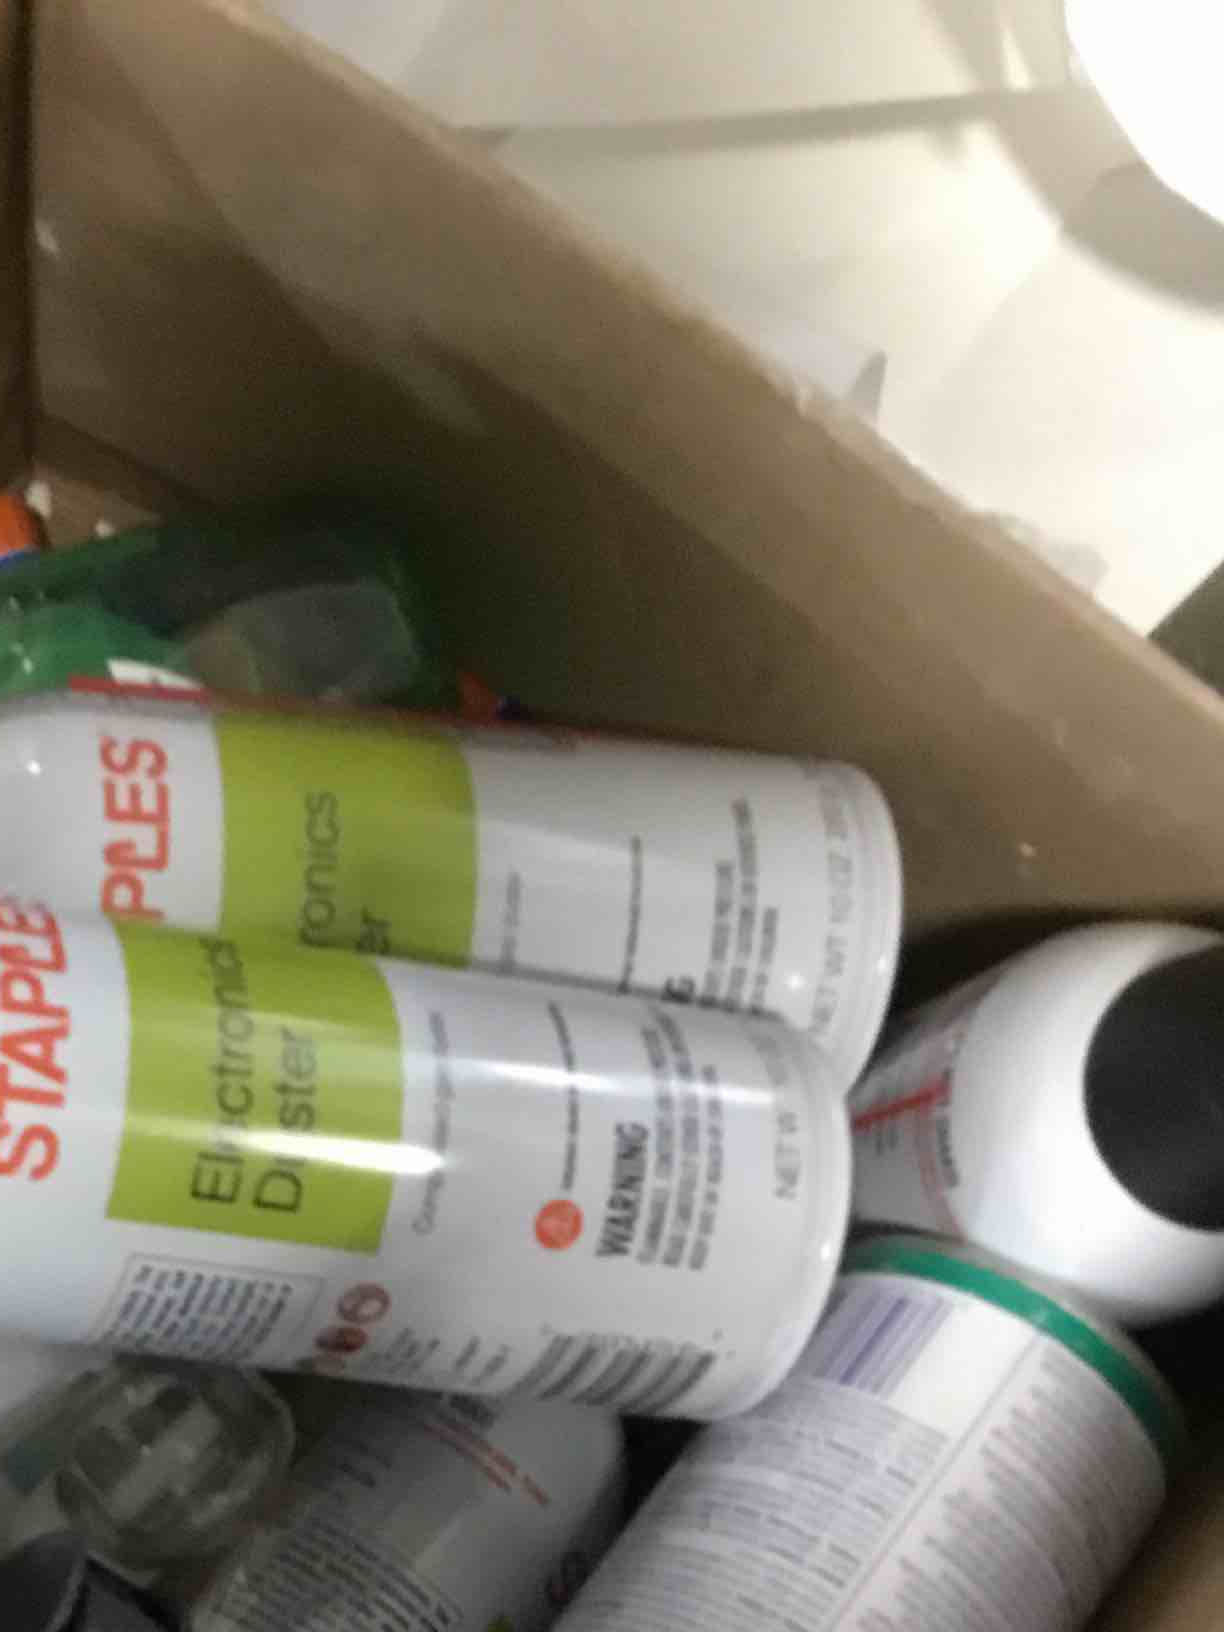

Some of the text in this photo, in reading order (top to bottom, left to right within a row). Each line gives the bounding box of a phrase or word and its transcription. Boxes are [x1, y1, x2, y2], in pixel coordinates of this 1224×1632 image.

[99, 735, 169, 922] PLES
[297, 790, 340, 950] ronics
[188, 937, 255, 1206] Elctronic
[595, 1121, 649, 1257] WARNING
